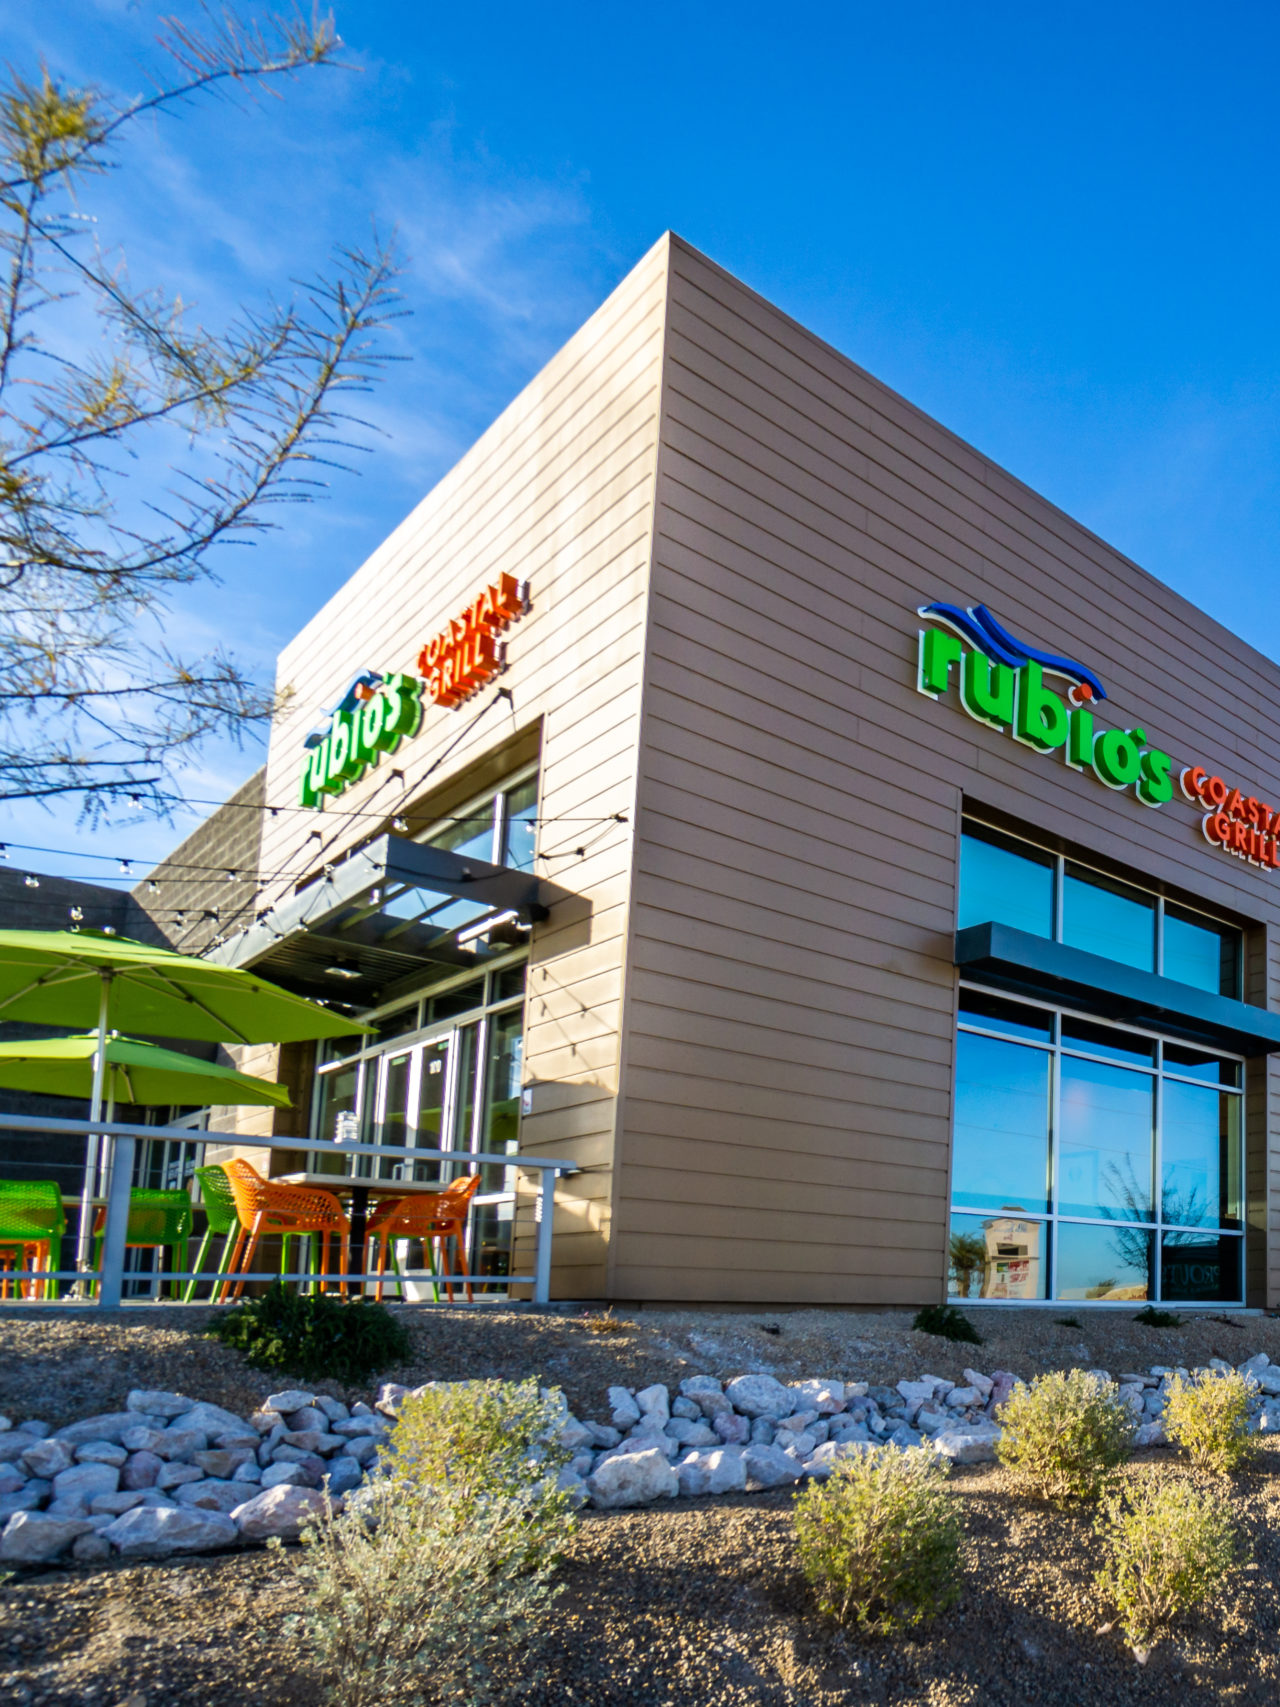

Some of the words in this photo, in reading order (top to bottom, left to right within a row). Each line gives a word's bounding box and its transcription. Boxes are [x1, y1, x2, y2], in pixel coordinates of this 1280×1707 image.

[417, 572, 523, 676] COASTAL
[427, 634, 500, 709] GRILL
[298, 672, 426, 812] rubio's
[916, 627, 1174, 809] rubio's
